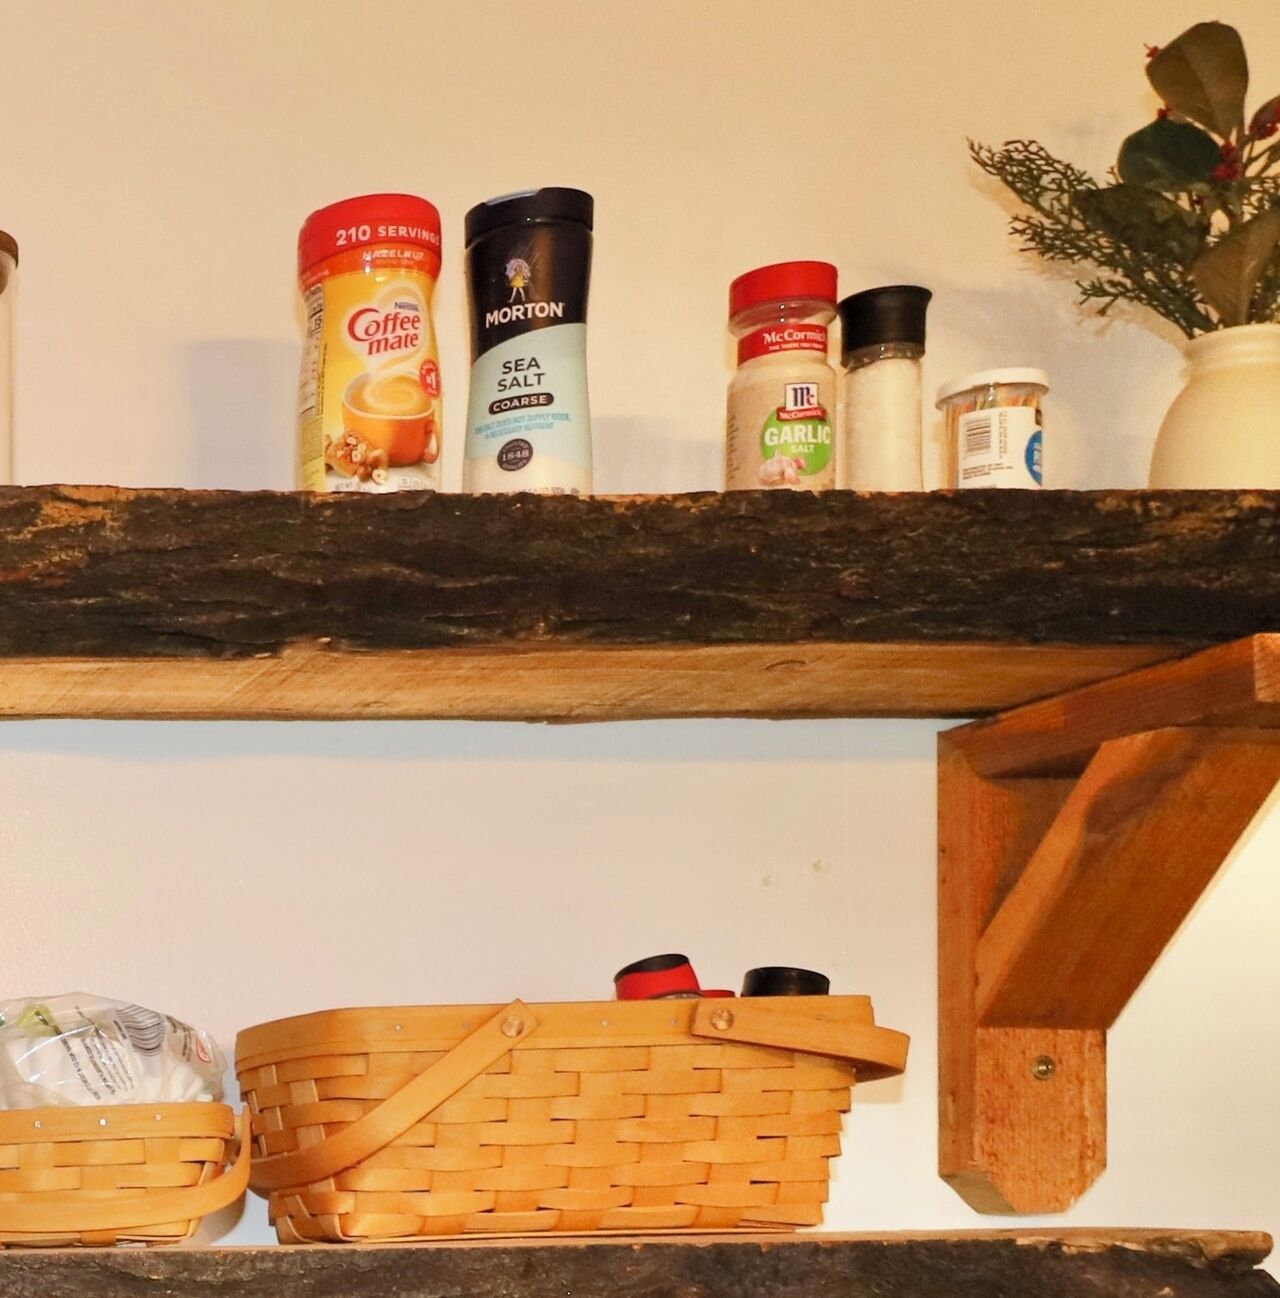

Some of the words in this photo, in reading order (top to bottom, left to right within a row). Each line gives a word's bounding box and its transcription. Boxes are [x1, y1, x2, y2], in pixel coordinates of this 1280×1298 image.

[335, 224, 371, 246] 210
[347, 308, 421, 342] Coffee
[485, 302, 564, 328] MORTON
[368, 332, 419, 356] mate
[502, 357, 541, 375] SEA
[497, 373, 546, 393] SALT
[492, 395, 547, 412] COARSE
[764, 424, 831, 446] GARLIC
[791, 444, 815, 453] SALT
